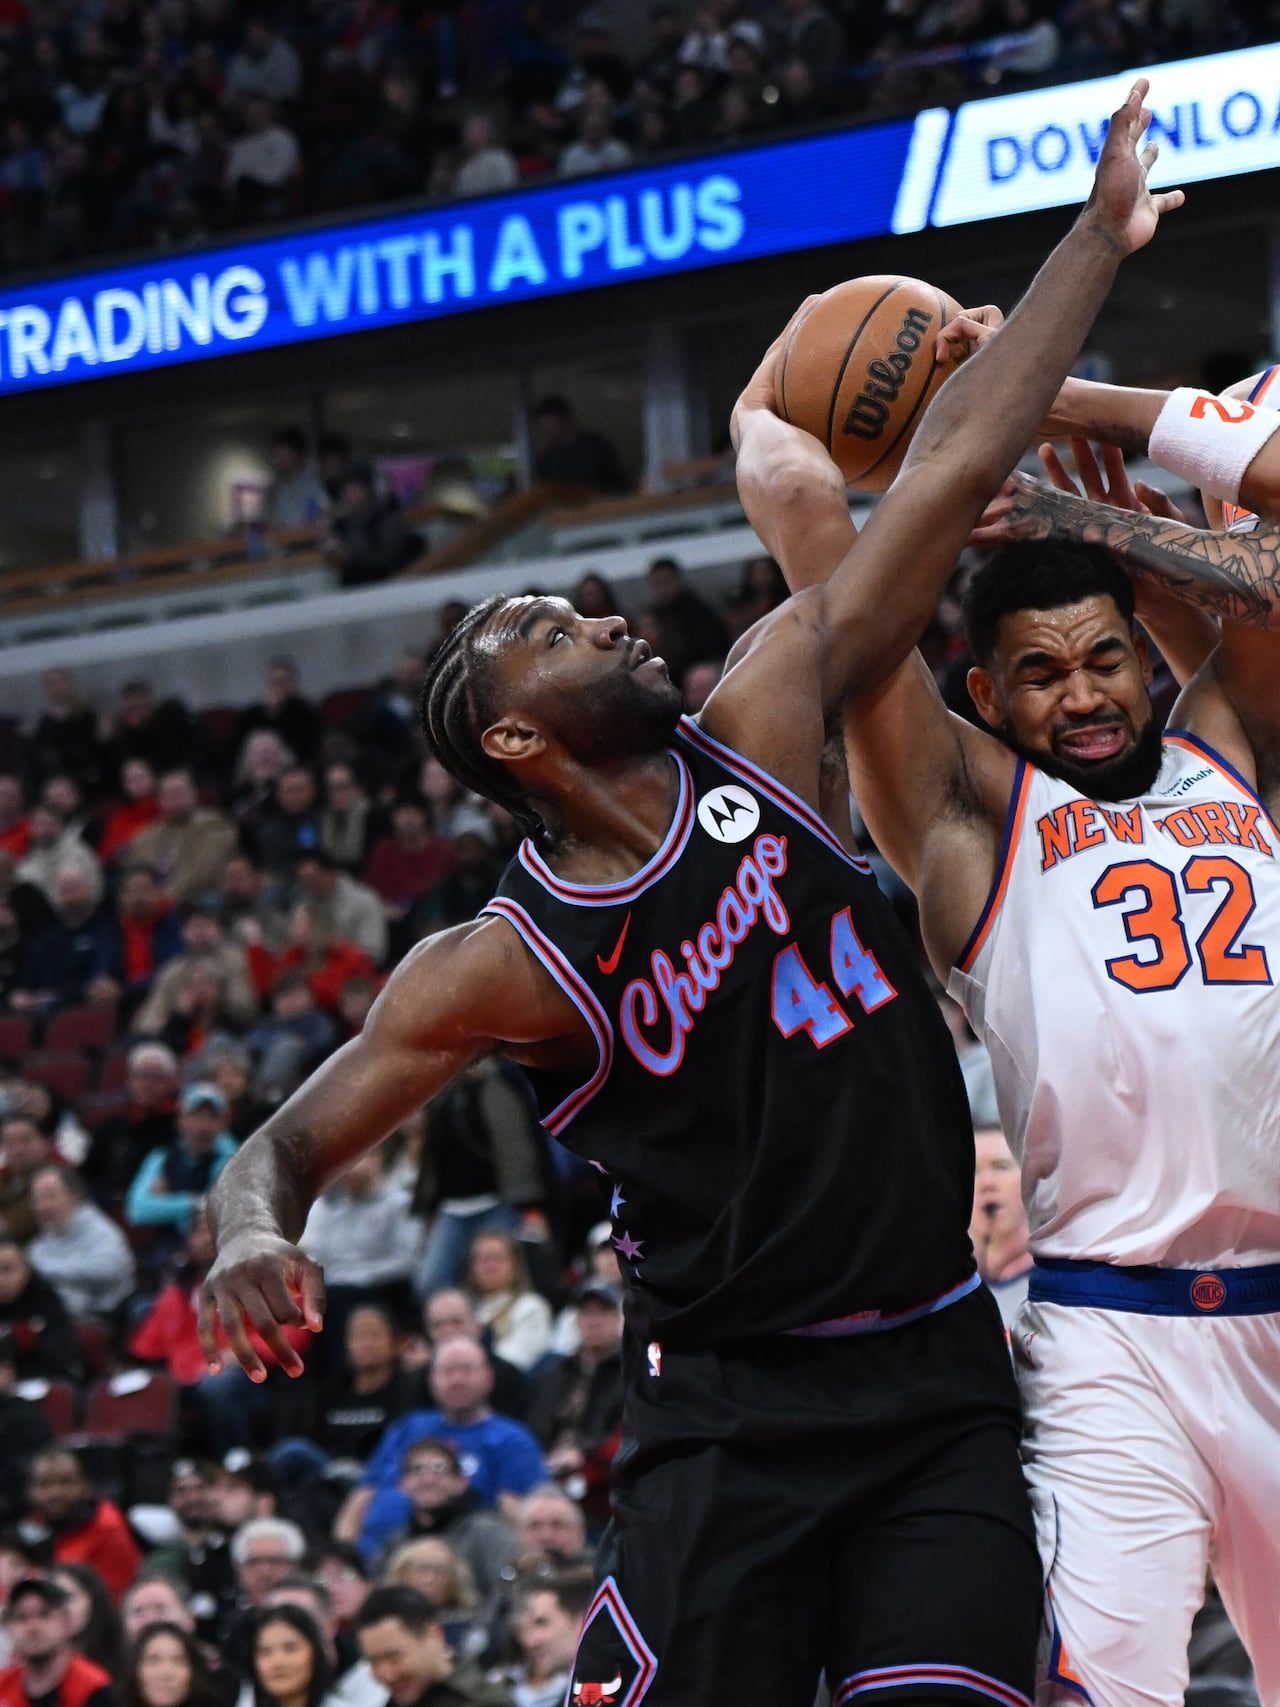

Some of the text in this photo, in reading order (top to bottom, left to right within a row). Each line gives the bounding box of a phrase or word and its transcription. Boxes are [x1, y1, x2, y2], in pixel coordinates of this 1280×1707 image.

[280, 223, 476, 328] WITH
[489, 213, 548, 293] A
[556, 175, 745, 280] PLUS
[842, 307, 933, 441] Wilson
[1037, 799, 1146, 875] NEW
[1181, 766, 1215, 791] dhabi
[619, 833, 790, 1077] Chicago
[770, 904, 899, 1050] 44
[1090, 854, 1274, 995] 32
